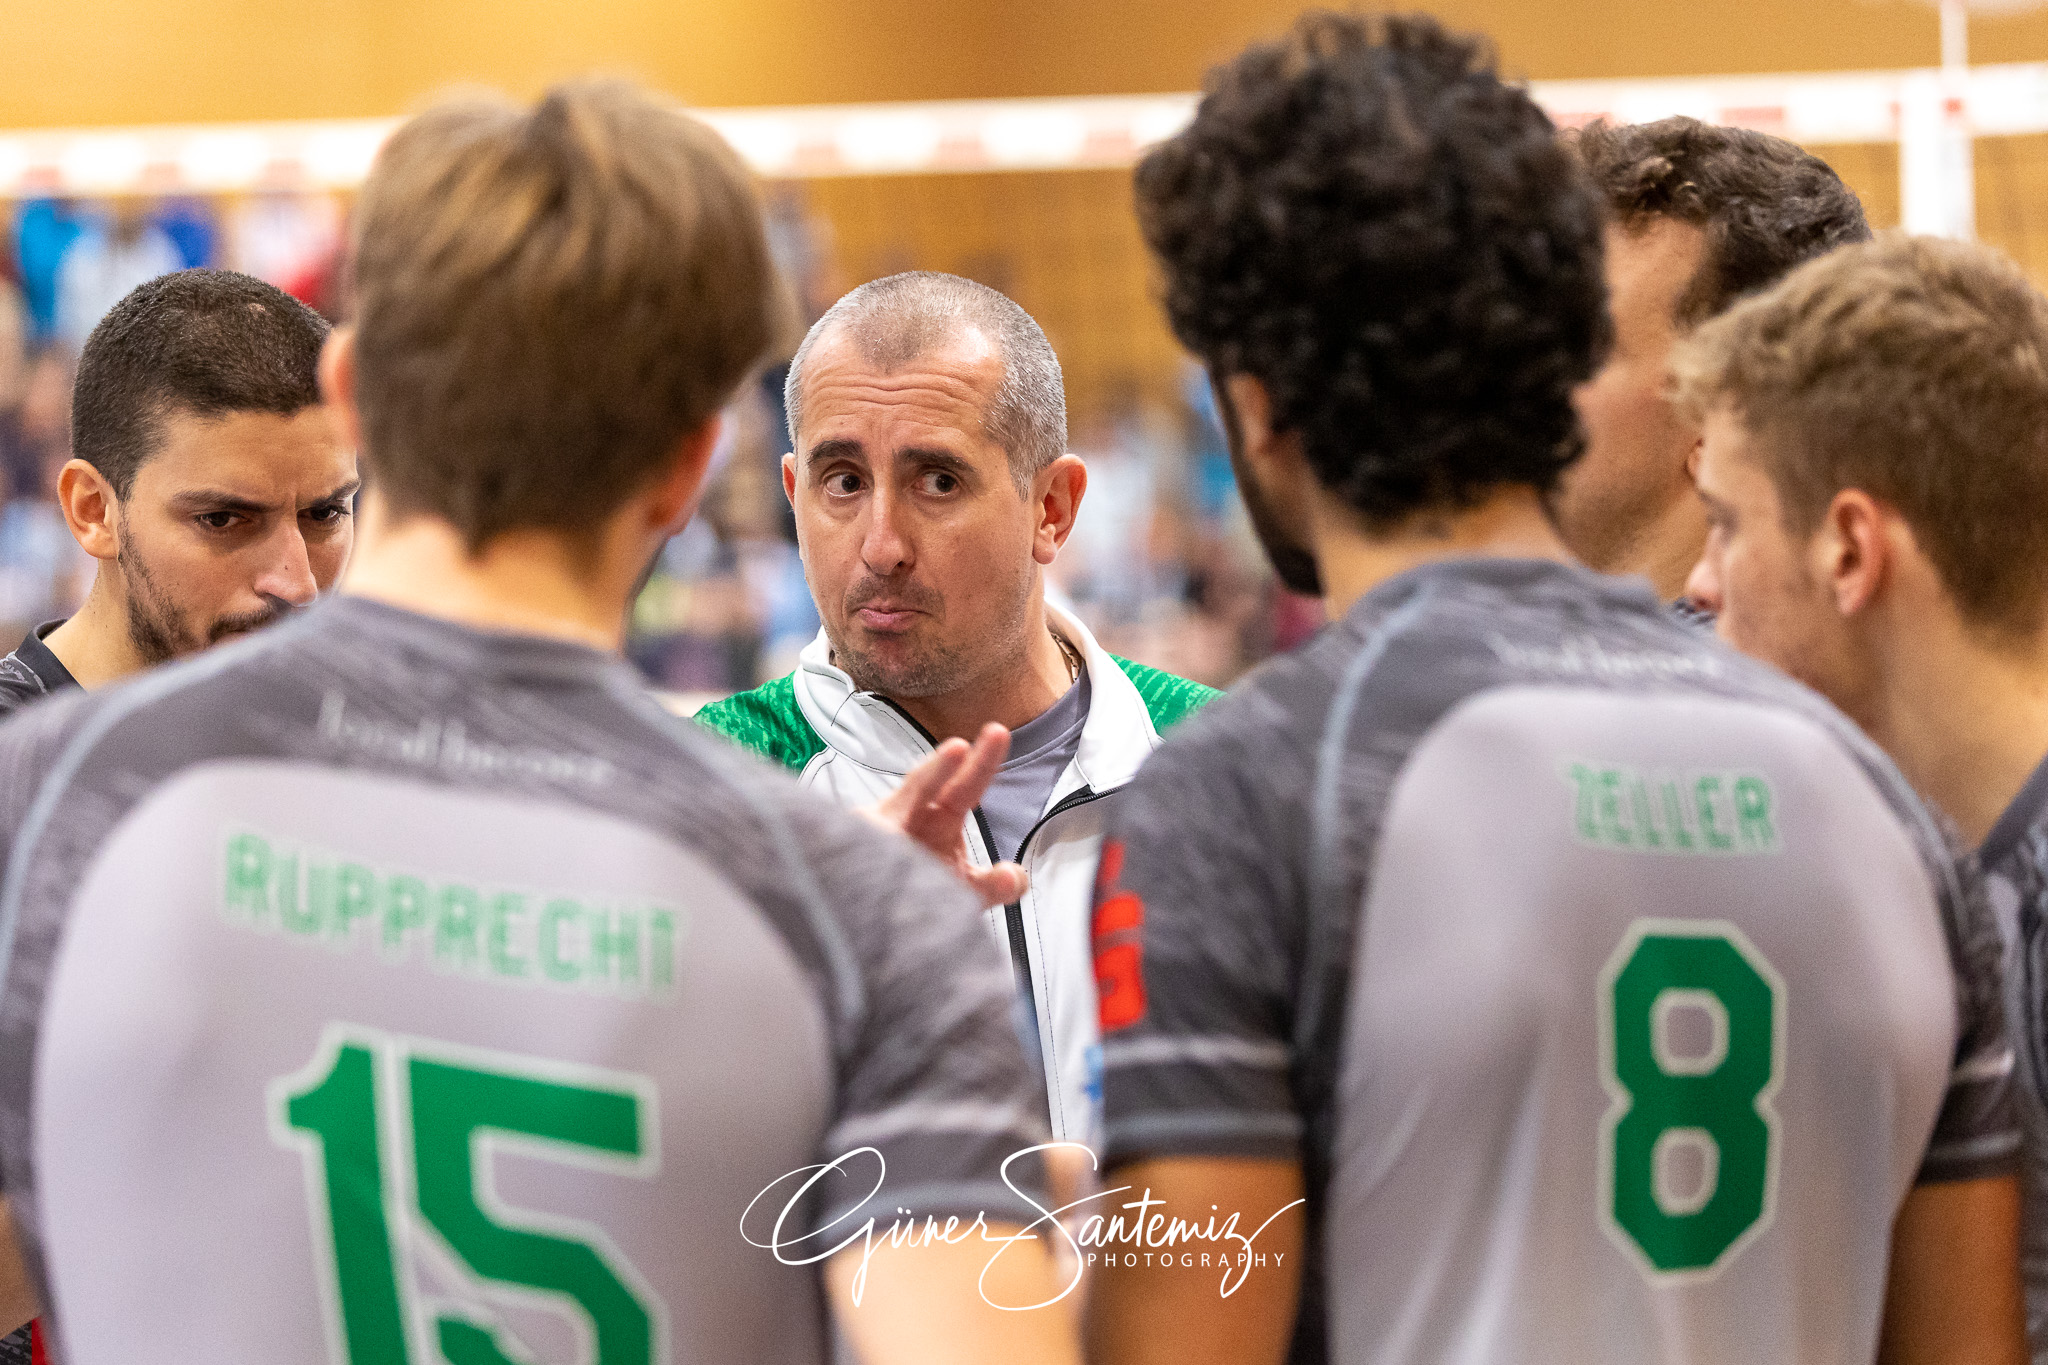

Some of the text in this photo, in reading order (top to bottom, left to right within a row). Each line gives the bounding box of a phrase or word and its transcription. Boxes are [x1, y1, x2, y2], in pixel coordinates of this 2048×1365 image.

[224, 831, 679, 990] RUPPRECHT
[1565, 761, 1777, 852] ZELLER
[270, 1026, 664, 1365] 15
[1602, 920, 1784, 1284] 8
